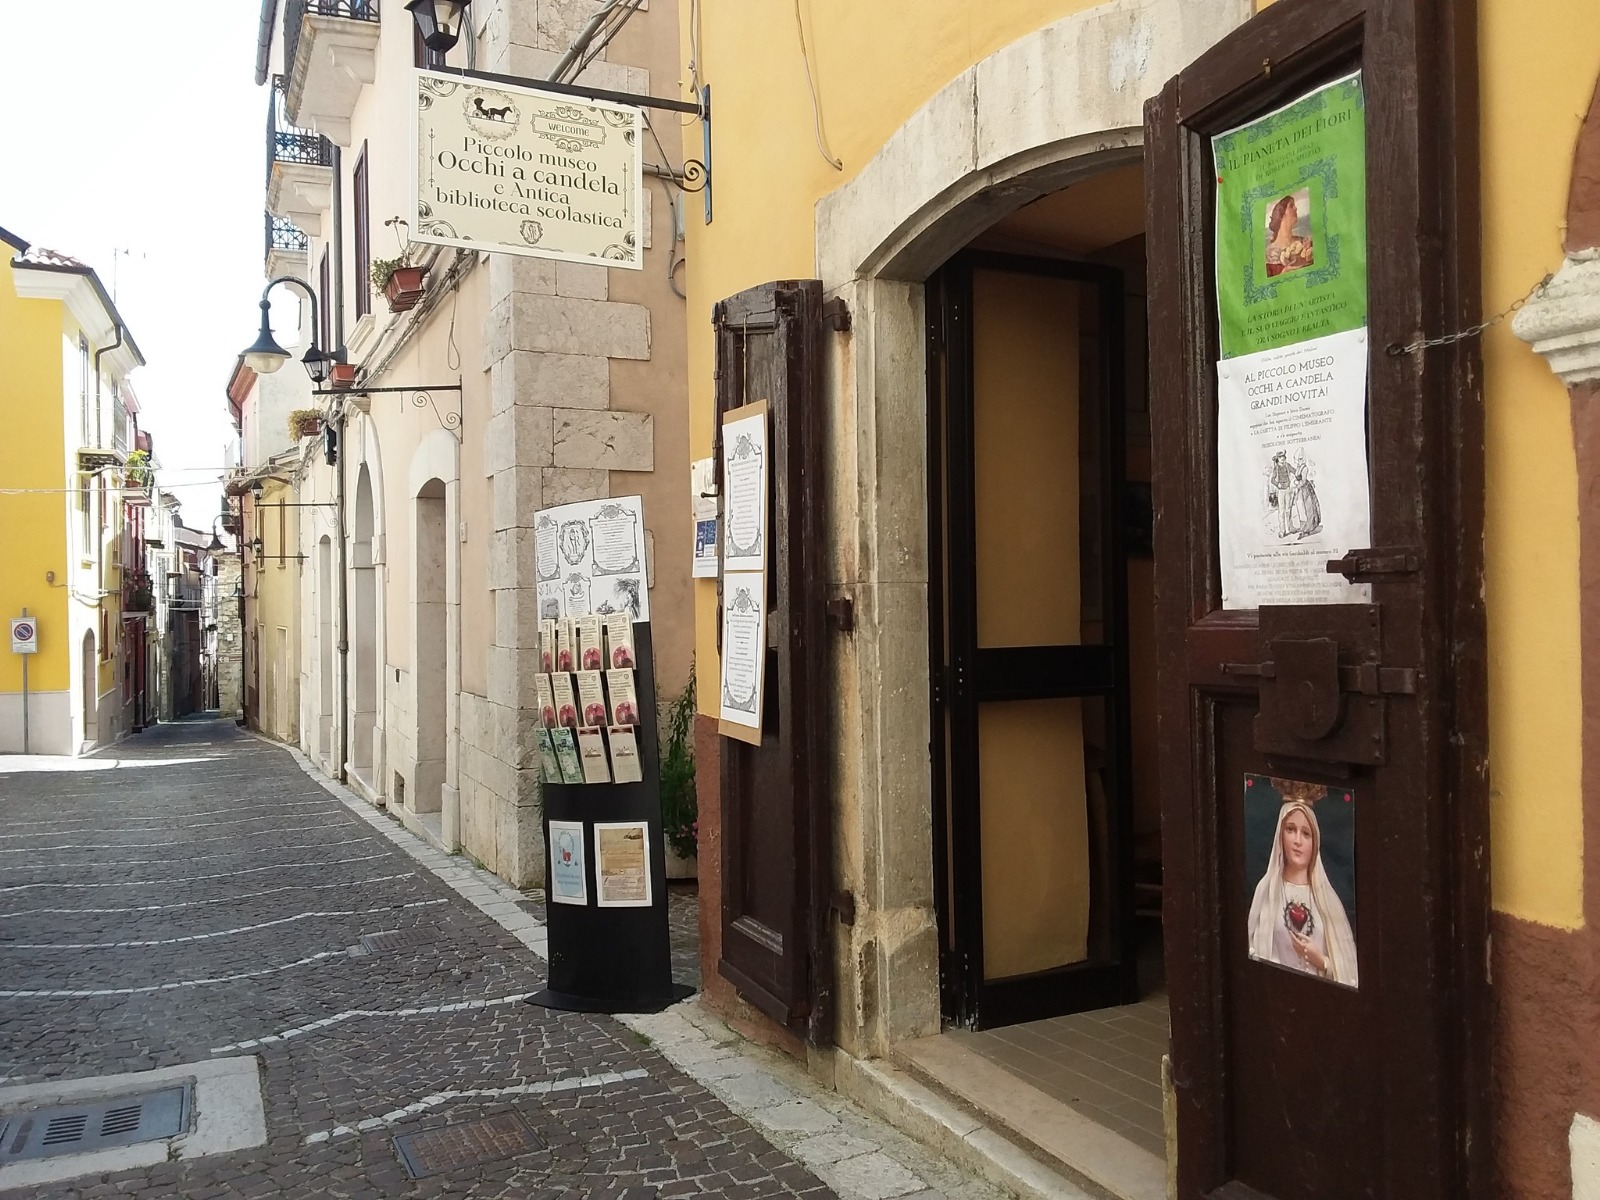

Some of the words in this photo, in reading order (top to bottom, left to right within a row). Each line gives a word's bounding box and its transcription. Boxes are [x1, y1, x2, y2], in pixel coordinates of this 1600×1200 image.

[548, 122, 590, 137] WELCOME
[1228, 159, 1240, 171] IL
[1243, 137, 1290, 166] PIANETA
[1293, 125, 1312, 143] DEI
[1316, 109, 1352, 132] FIORI
[463, 136, 533, 162] Piccolo
[539, 153, 597, 173] museo
[438, 150, 505, 178] Occhi
[512, 166, 526, 181] a
[533, 169, 620, 196] candela
[436, 186, 530, 216] biblioteca
[536, 204, 623, 229] scolastica
[494, 182, 504, 195] e
[510, 181, 570, 205] Antica
[1245, 373, 1256, 384] AL
[1257, 363, 1296, 380] PICCOLO
[1299, 355, 1335, 371] MUSEO
[1248, 382, 1274, 397] OCCHI
[1276, 382, 1283, 391] A
[1285, 371, 1334, 388] CANDELA
[1250, 395, 1283, 410] GRANDI
